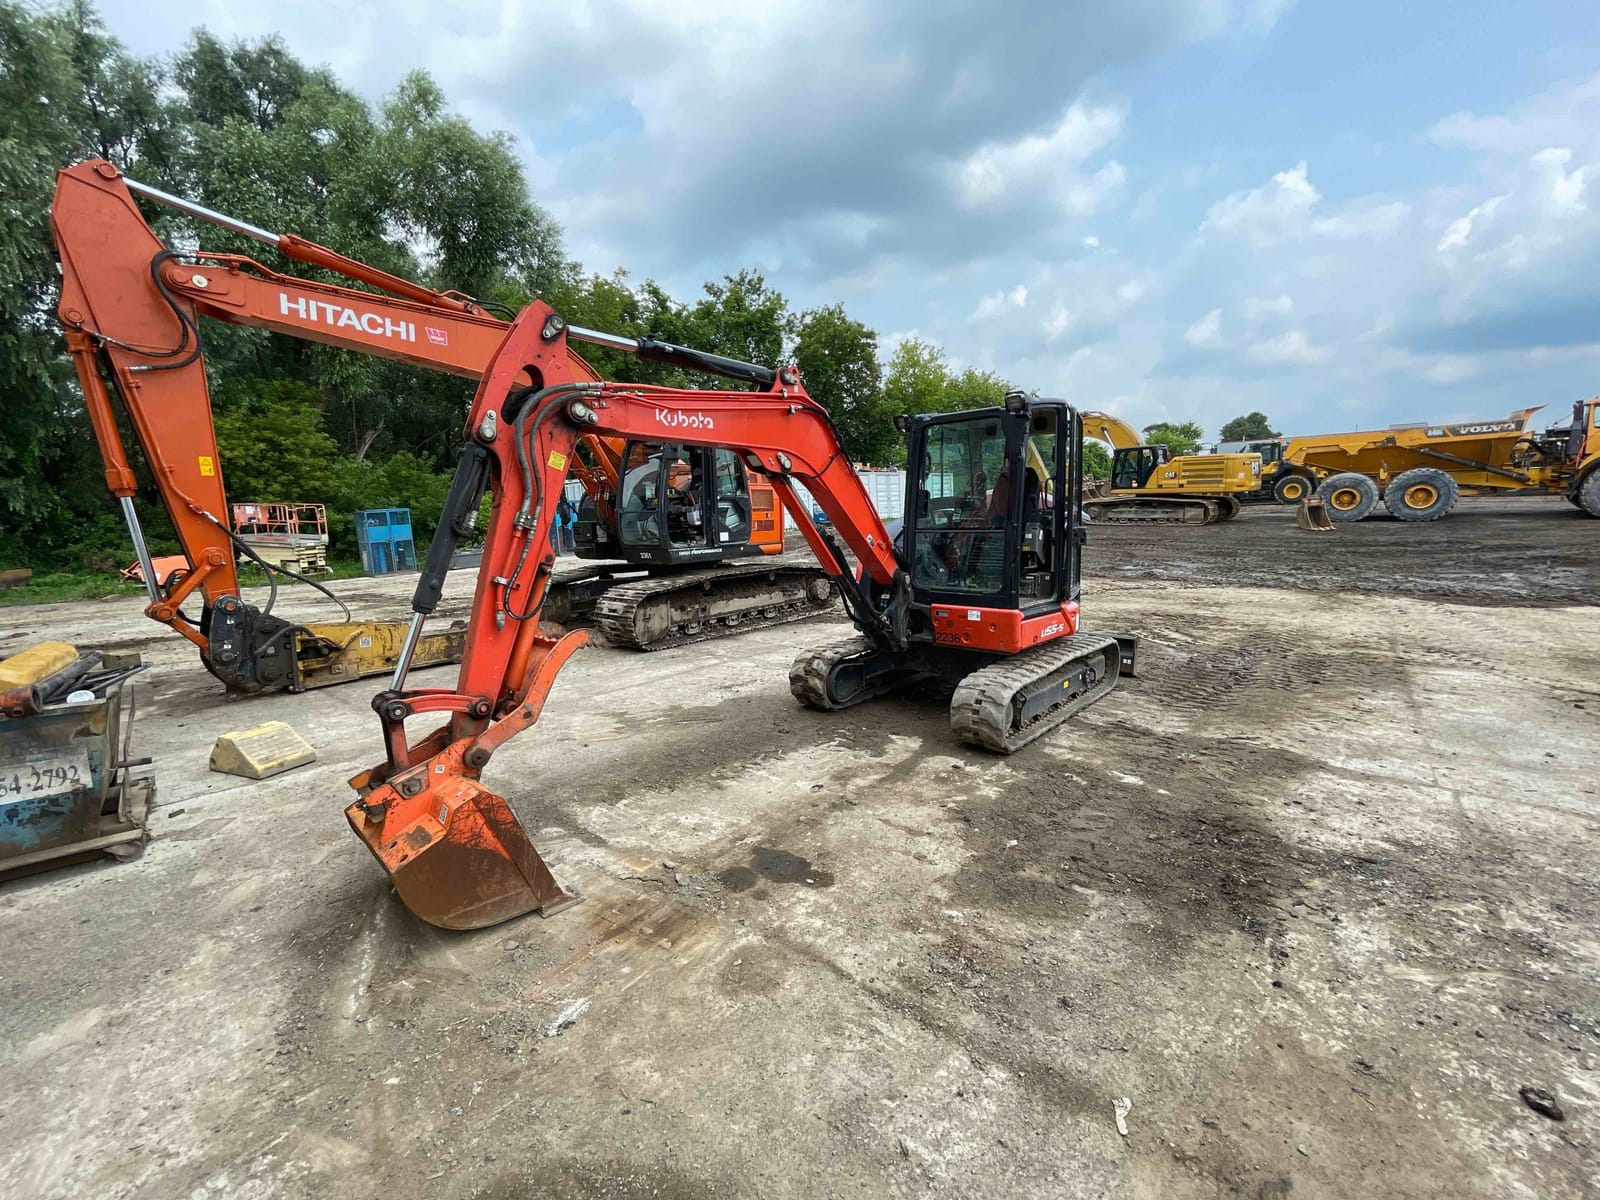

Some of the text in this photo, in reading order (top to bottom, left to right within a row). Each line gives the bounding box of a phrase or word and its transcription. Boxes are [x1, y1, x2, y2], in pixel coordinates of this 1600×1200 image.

[279, 293, 416, 342] HITACHI
[655, 408, 714, 430] Kubota
[935, 632, 962, 643] 2236
